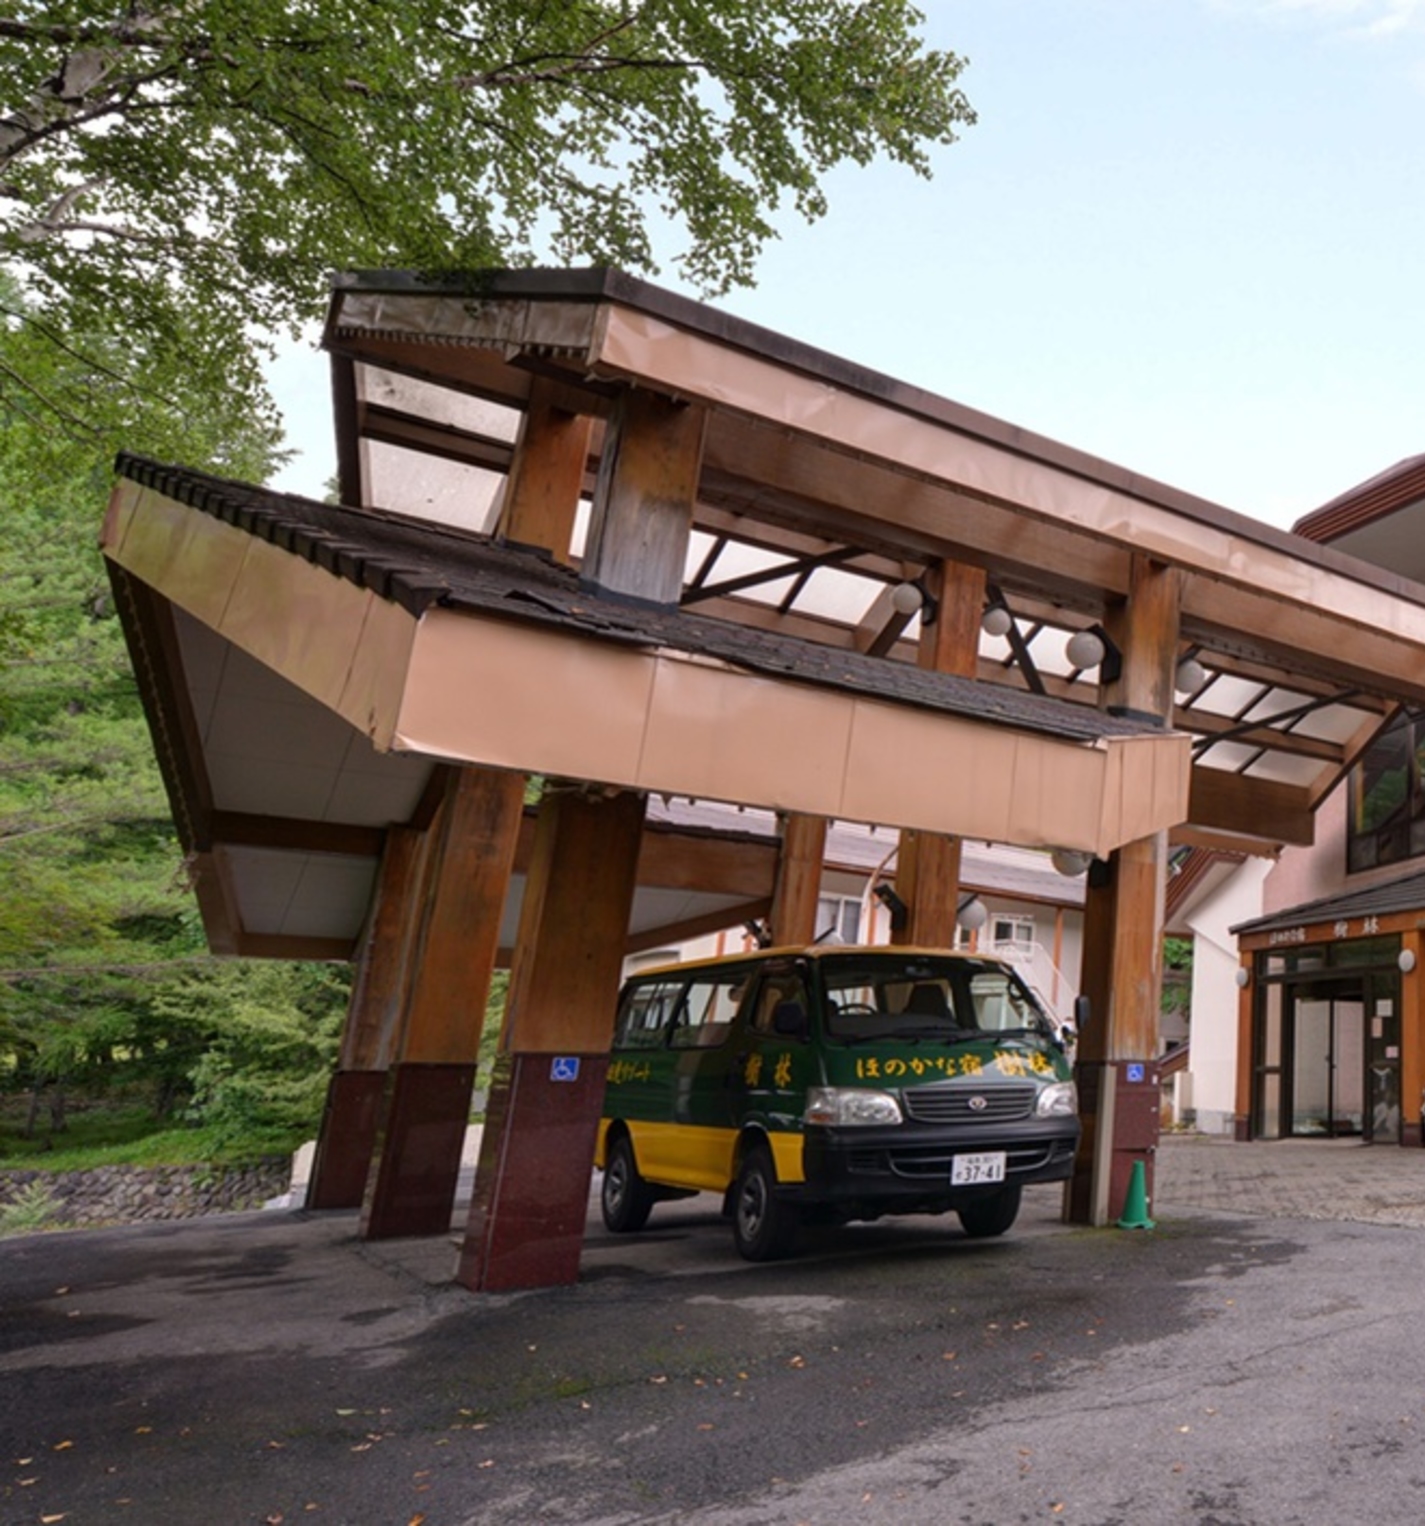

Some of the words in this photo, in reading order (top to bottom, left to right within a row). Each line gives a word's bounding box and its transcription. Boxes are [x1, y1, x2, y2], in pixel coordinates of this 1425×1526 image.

[744, 1052, 791, 1088] 樹林
[856, 1053, 984, 1079] ほのかな宿
[963, 1164, 1001, 1182] 37-41
